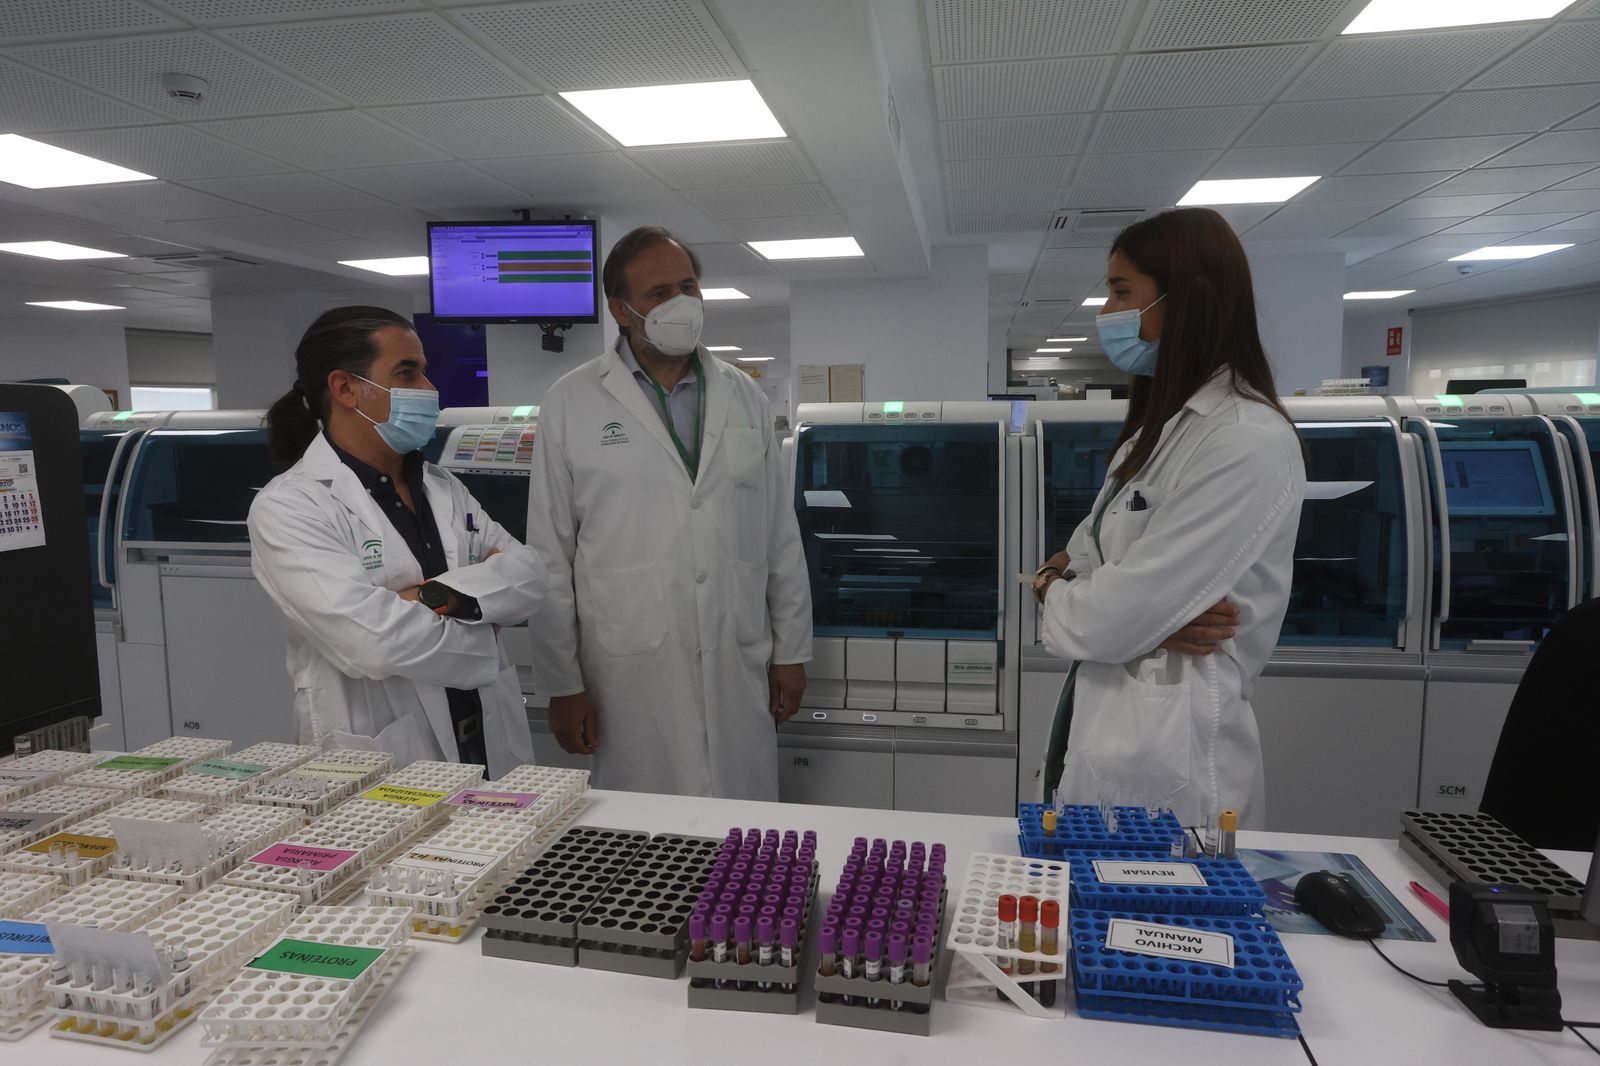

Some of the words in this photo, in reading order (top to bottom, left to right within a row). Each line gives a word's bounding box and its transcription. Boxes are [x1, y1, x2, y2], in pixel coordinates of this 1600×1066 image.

[0, 423, 25, 432] NOS
[1439, 785, 1465, 796] SCM
[383, 793, 419, 802] ALERGIA
[283, 848, 338, 859] PRIMARIA
[1122, 869, 1176, 877] REVISAR
[1136, 928, 1202, 944] MANUAL
[1135, 938, 1203, 954] ARCHIVO
